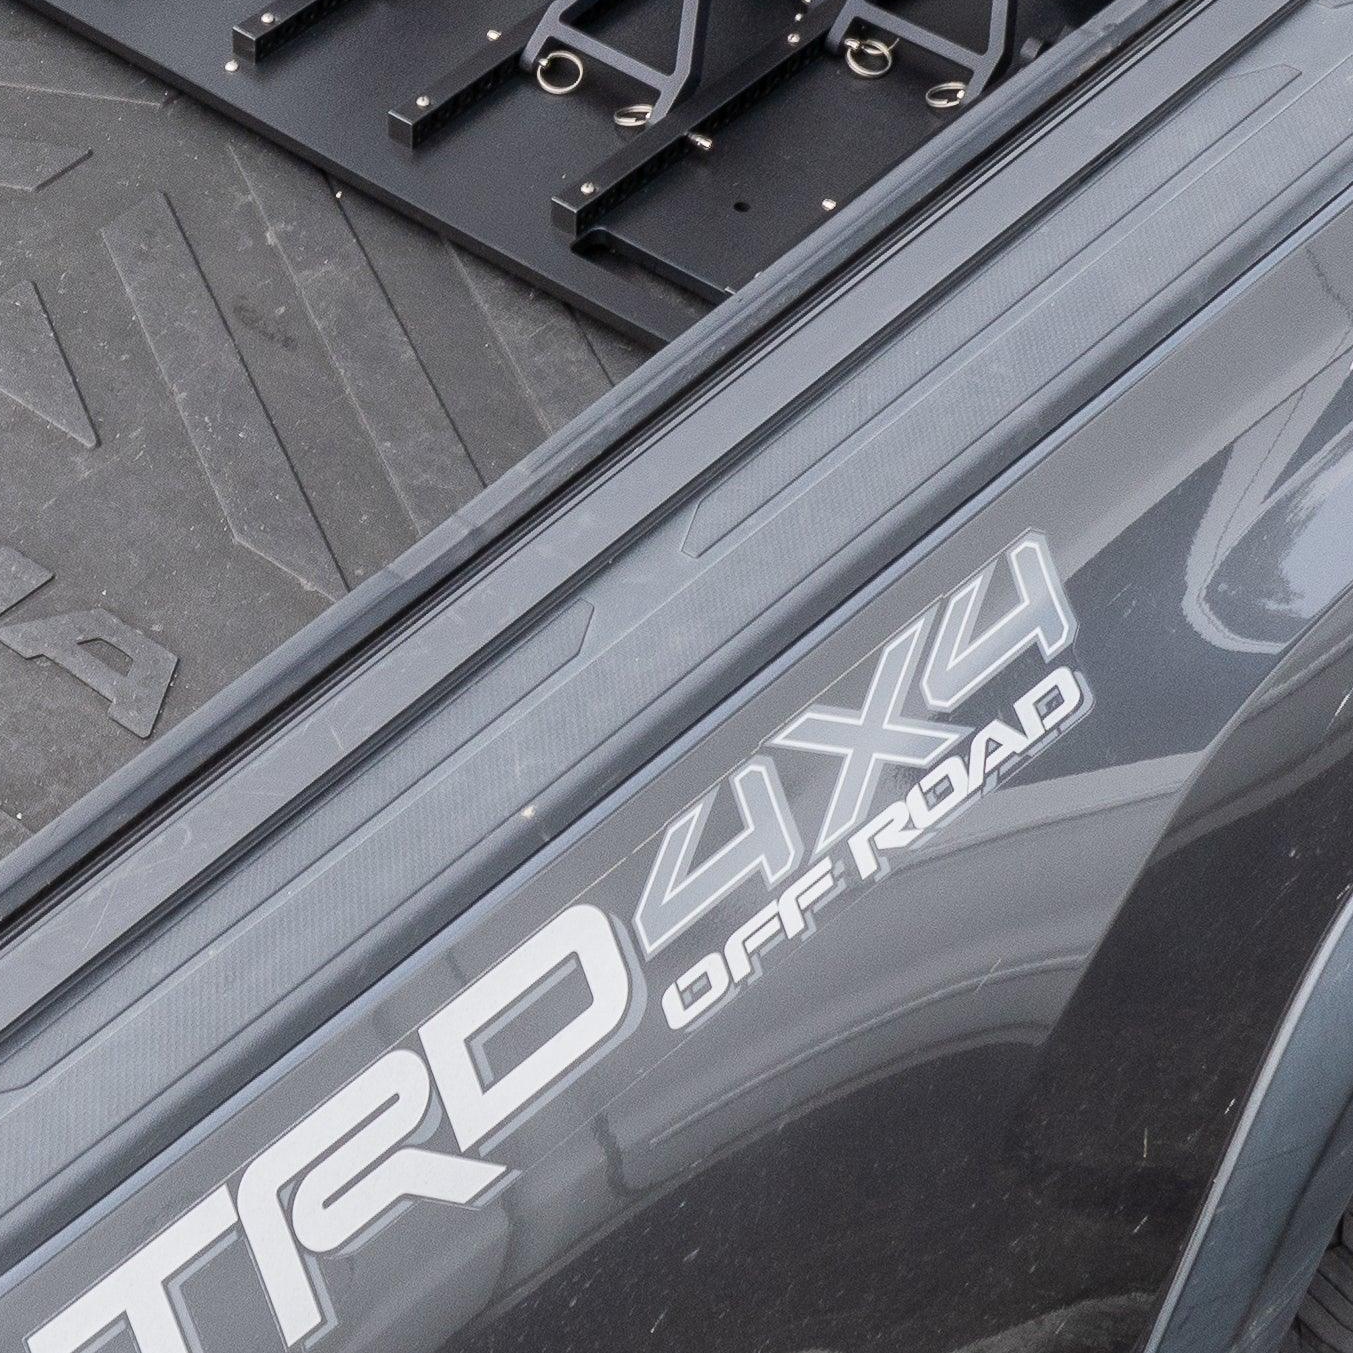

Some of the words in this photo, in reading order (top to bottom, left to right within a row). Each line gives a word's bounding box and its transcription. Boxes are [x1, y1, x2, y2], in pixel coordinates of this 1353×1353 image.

[633, 529, 1080, 965] 4X4
[661, 856, 838, 1032] OFF
[848, 665, 1086, 882] ROAD
[25, 902, 638, 1353] TRD
